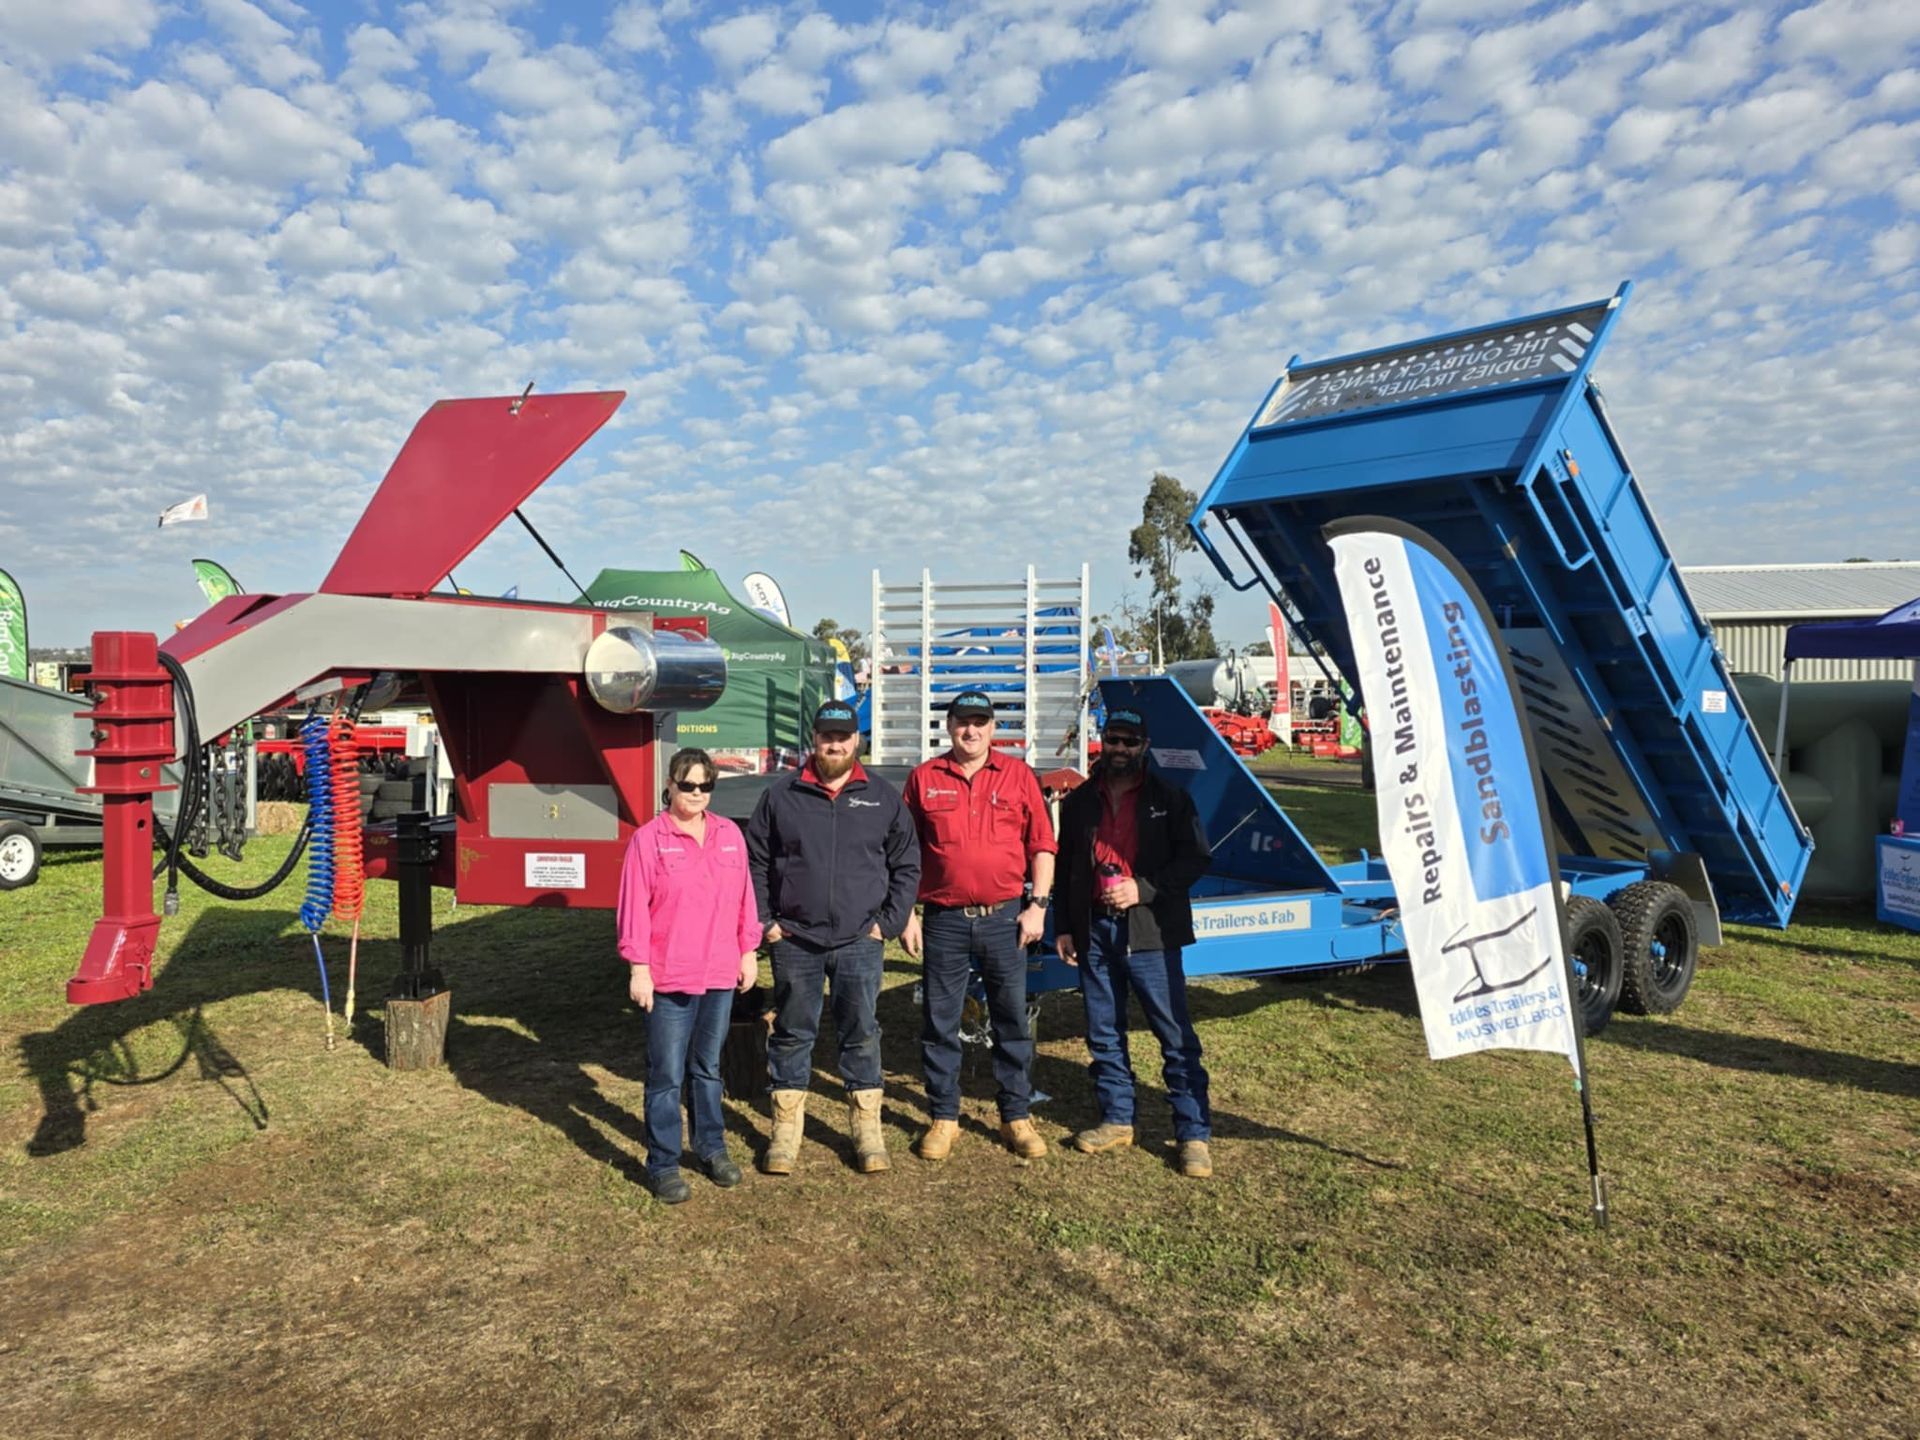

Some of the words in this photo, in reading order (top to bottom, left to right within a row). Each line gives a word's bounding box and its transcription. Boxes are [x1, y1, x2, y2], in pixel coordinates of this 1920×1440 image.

[1364, 556, 1417, 757] Maintenance
[1442, 600, 1510, 846] Sandblasting
[1400, 763, 1419, 785] &
[1405, 792, 1443, 905] Repairs
[1202, 913, 1256, 931] Trailers
[1258, 911, 1269, 926] &
[1271, 908, 1296, 925] Fab
[1491, 990, 1546, 1014] Trailers
